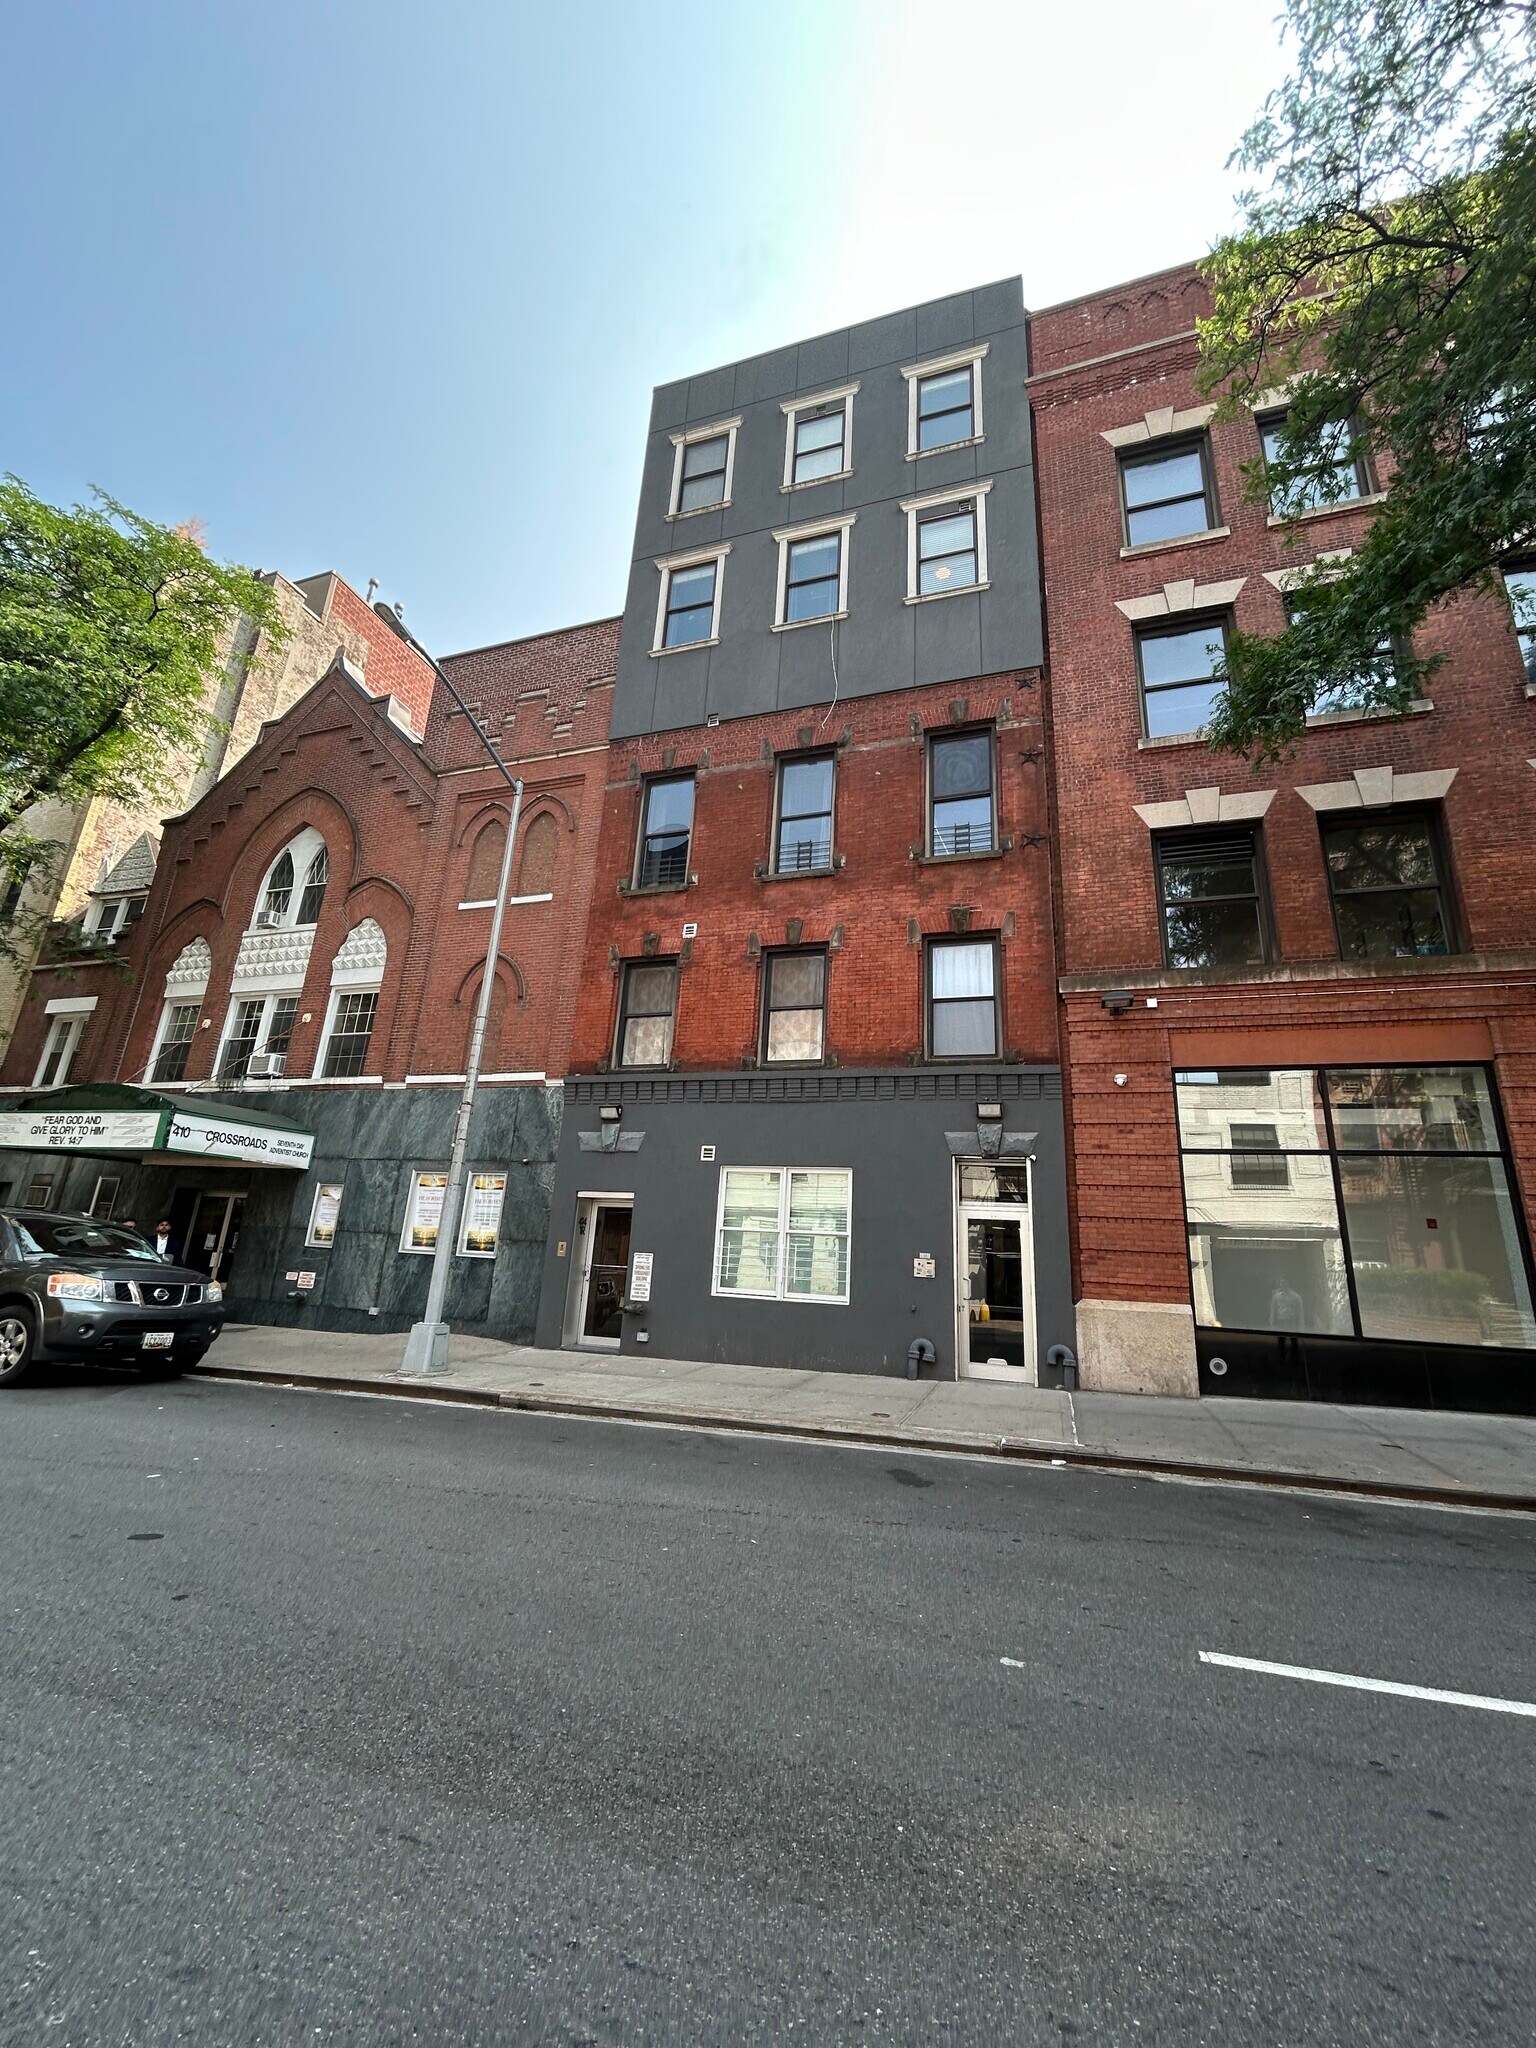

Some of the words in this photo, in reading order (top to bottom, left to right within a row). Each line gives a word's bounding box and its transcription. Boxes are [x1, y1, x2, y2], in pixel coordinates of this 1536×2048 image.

[66, 1116, 83, 1124] GOD
[84, 1116, 102, 1124] AND
[30, 1126, 48, 1134] GIVE
[50, 1126, 76, 1134] GLORY
[78, 1126, 88, 1135] TO
[48, 1136, 66, 1144] REV.
[68, 1136, 83, 1144] 14:7
[172, 1126, 190, 1138] 410
[206, 1130, 268, 1150] CROSSROADS
[276, 1140, 296, 1148] SEVENTH
[269, 1147, 292, 1156] ADVENTIST
[292, 1150, 309, 1158] CHURCH
